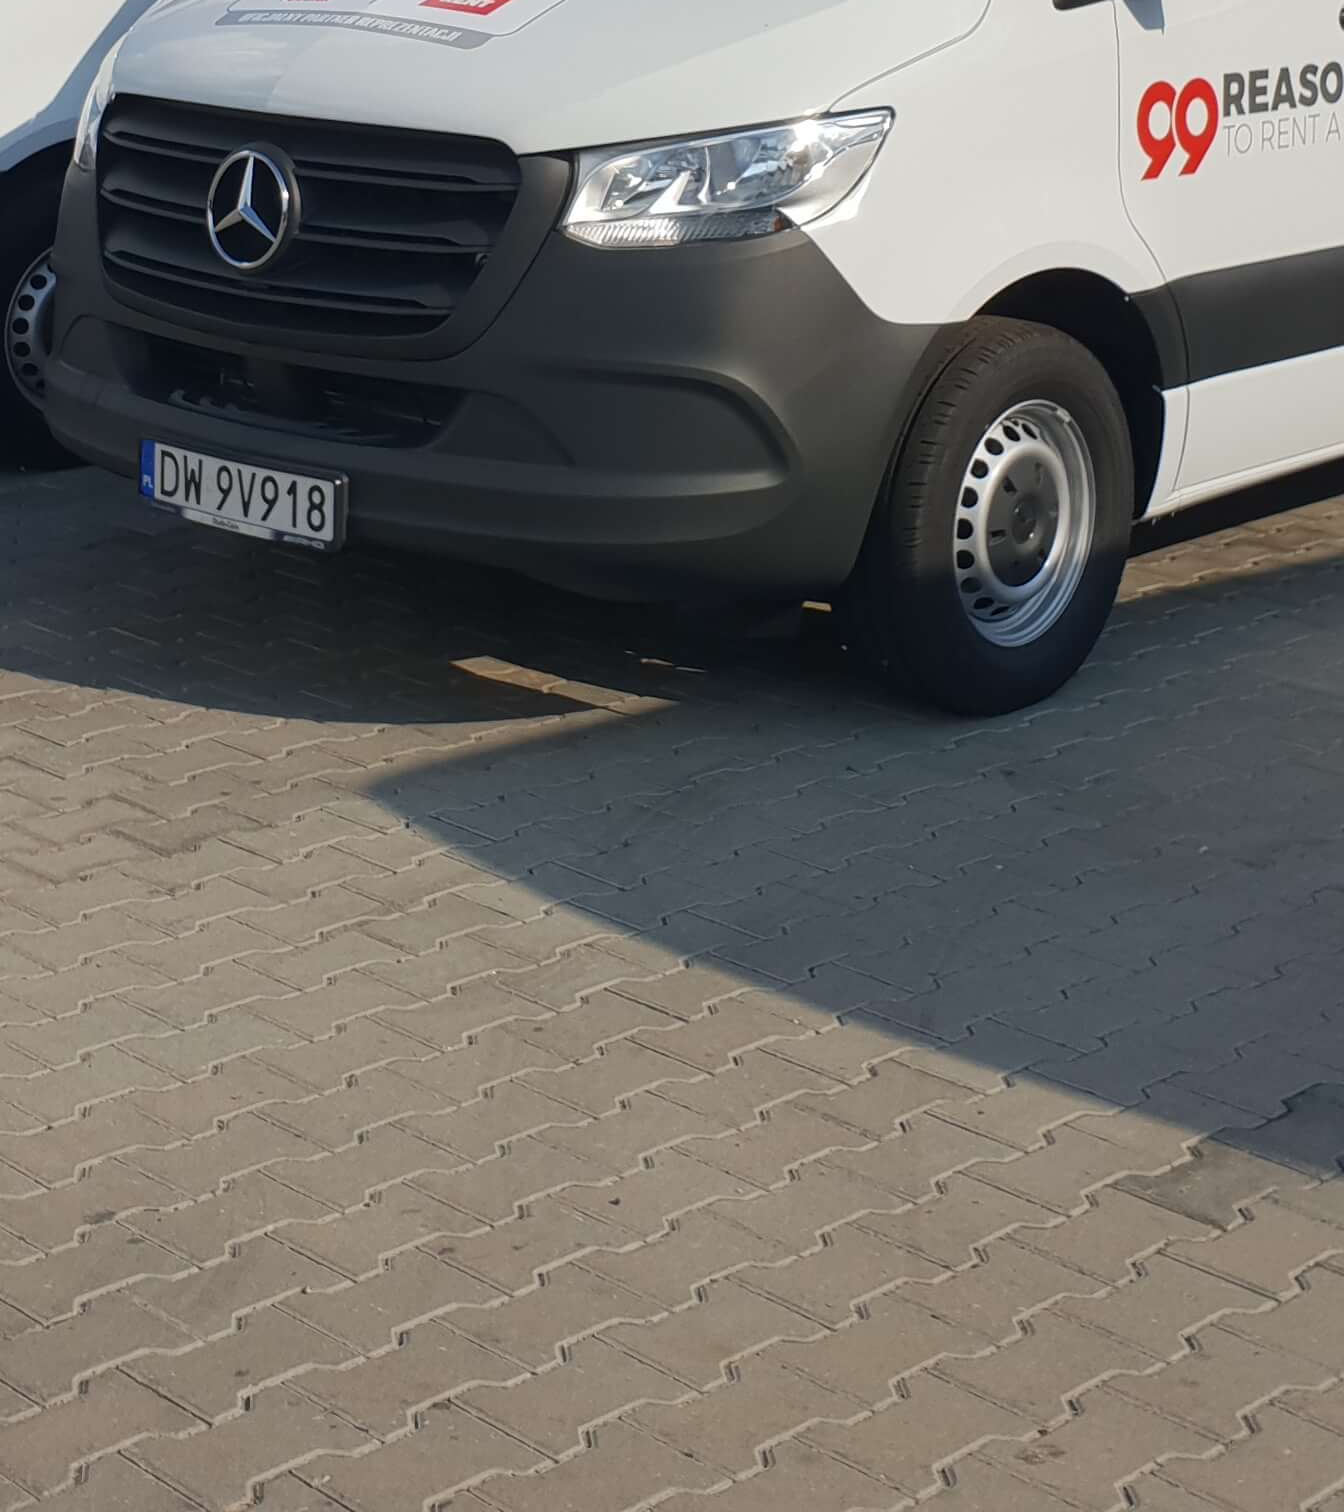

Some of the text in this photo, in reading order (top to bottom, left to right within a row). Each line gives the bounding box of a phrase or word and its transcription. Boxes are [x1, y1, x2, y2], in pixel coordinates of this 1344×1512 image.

[1137, 77, 1219, 181] 99
[1223, 122, 1253, 158] TO
[1261, 113, 1320, 153] RENT
[1325, 111, 1341, 143] A
[160, 450, 326, 533] DW 9V918
